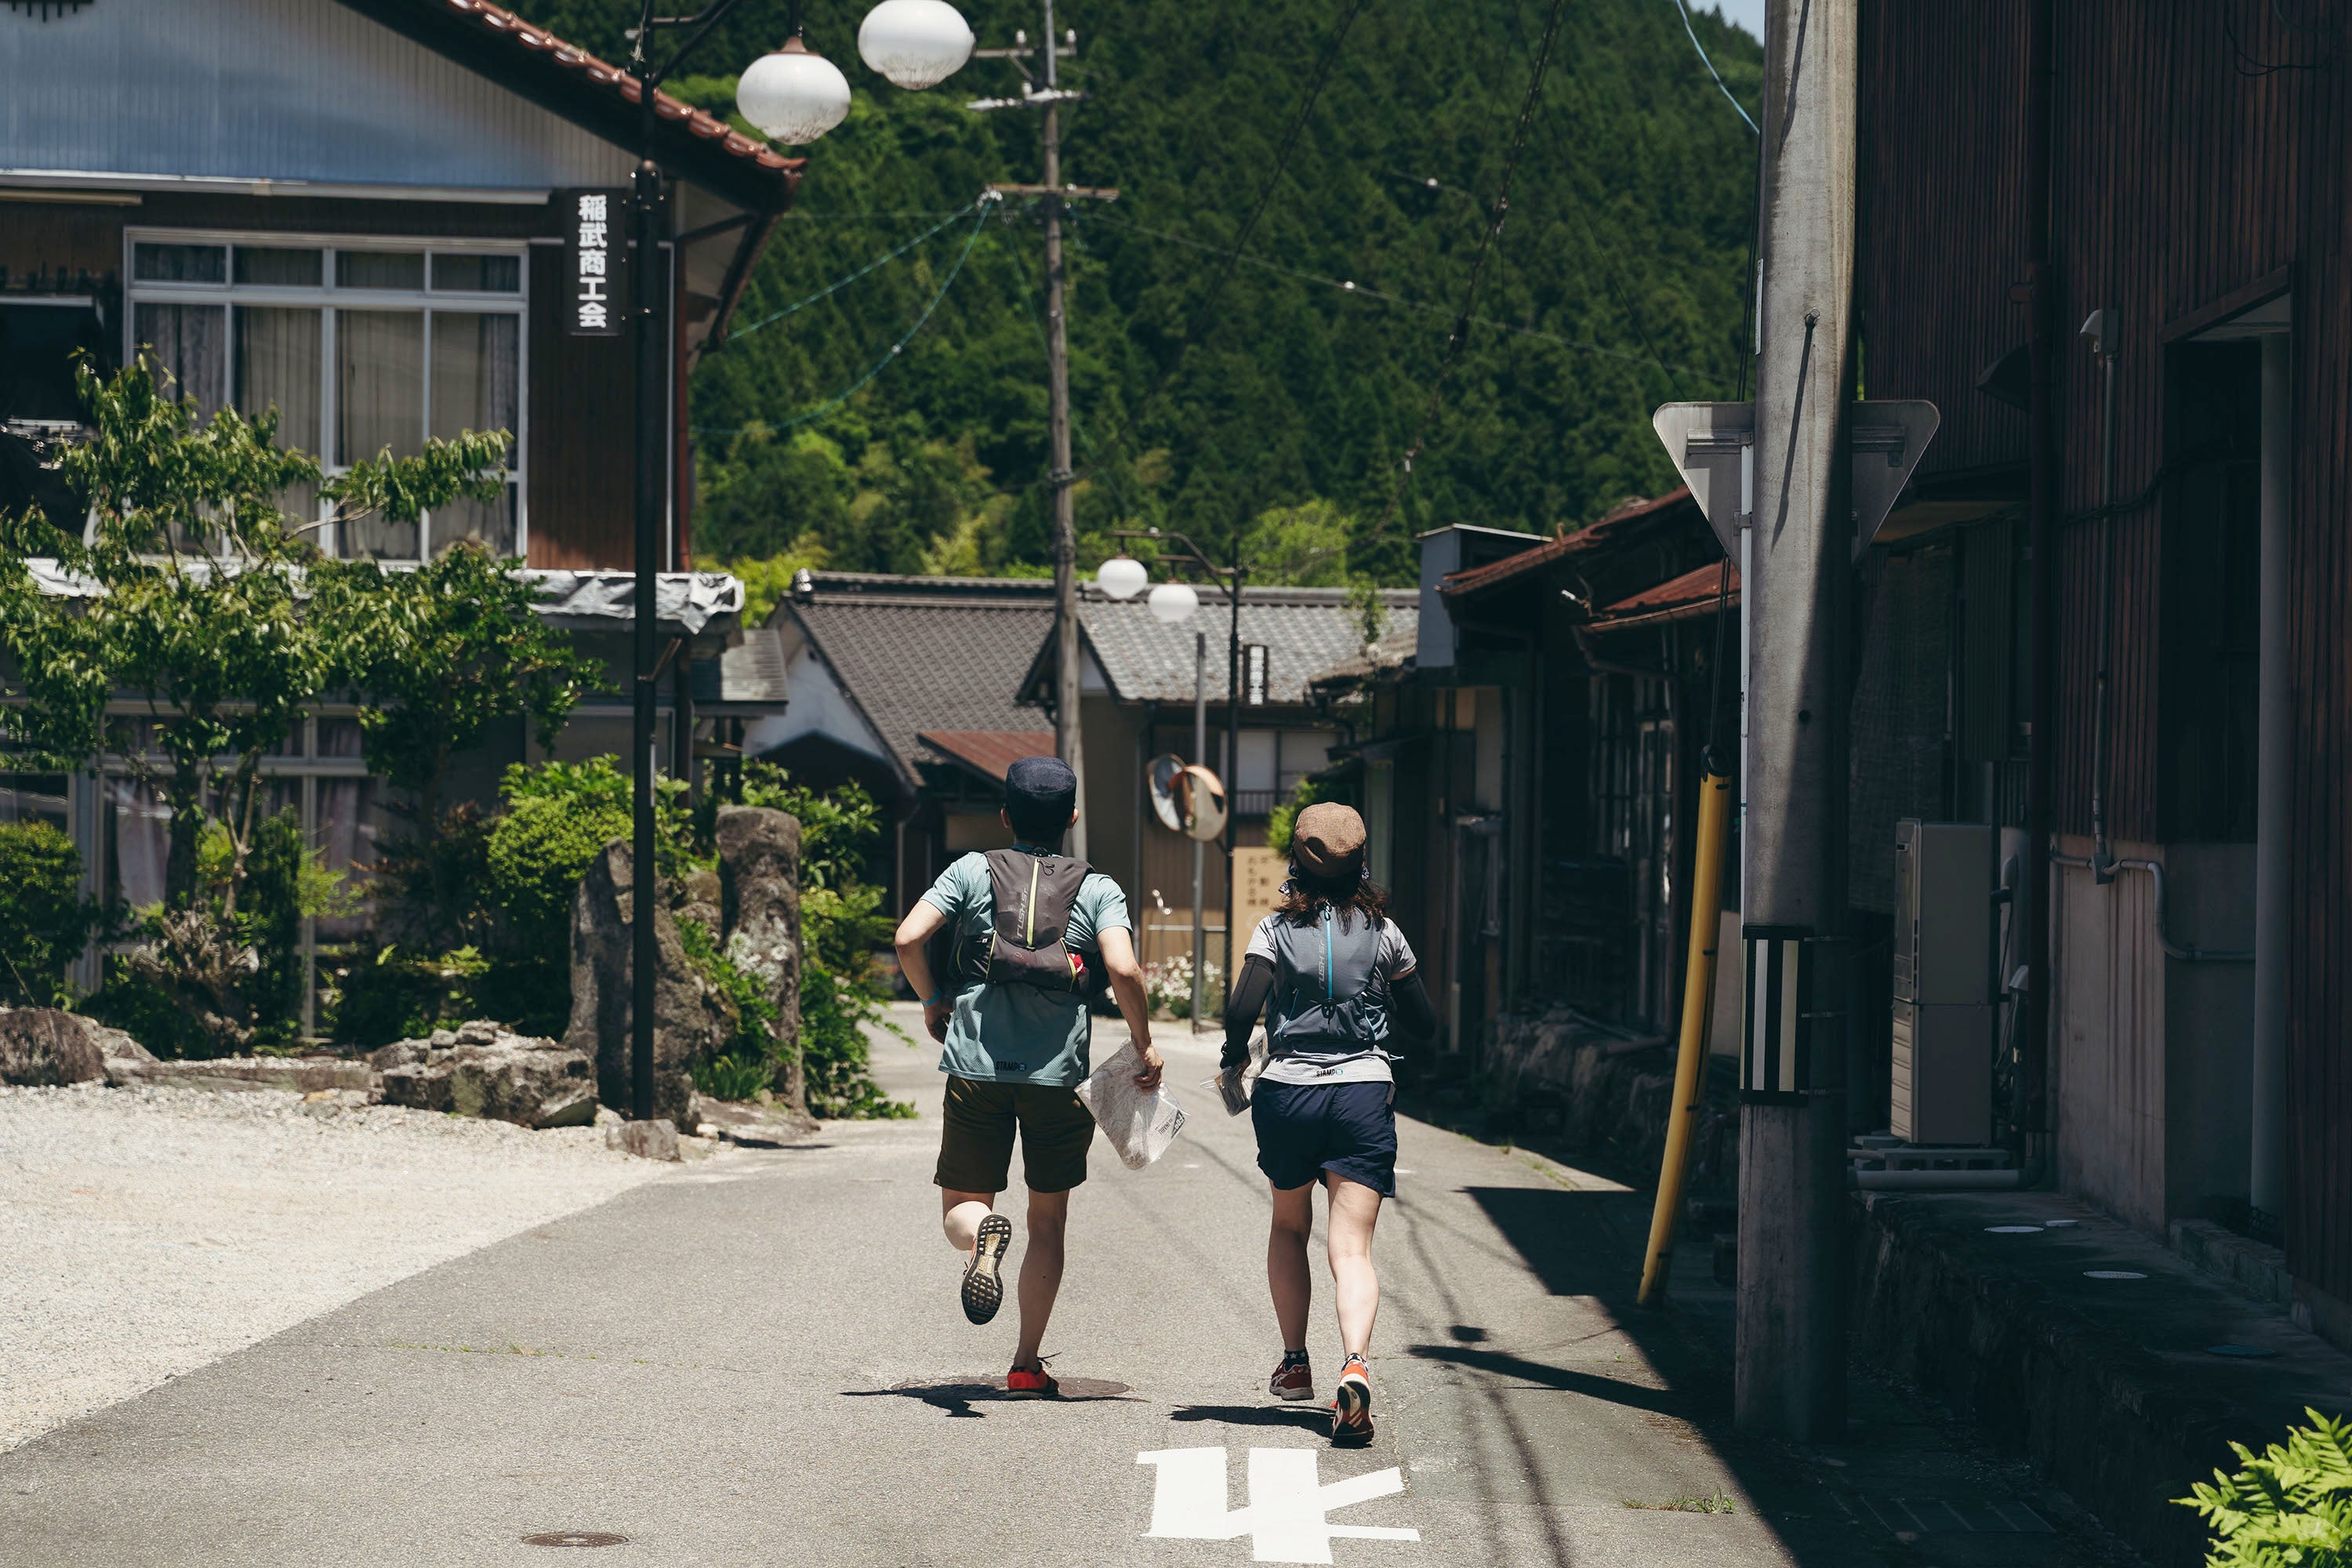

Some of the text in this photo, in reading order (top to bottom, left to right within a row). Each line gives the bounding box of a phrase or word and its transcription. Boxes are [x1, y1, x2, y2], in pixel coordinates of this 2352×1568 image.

[578, 194, 608, 328] 稲武商工会
[995, 1061, 1017, 1071] STAMP
[1316, 1069, 1336, 1078] STAMP
